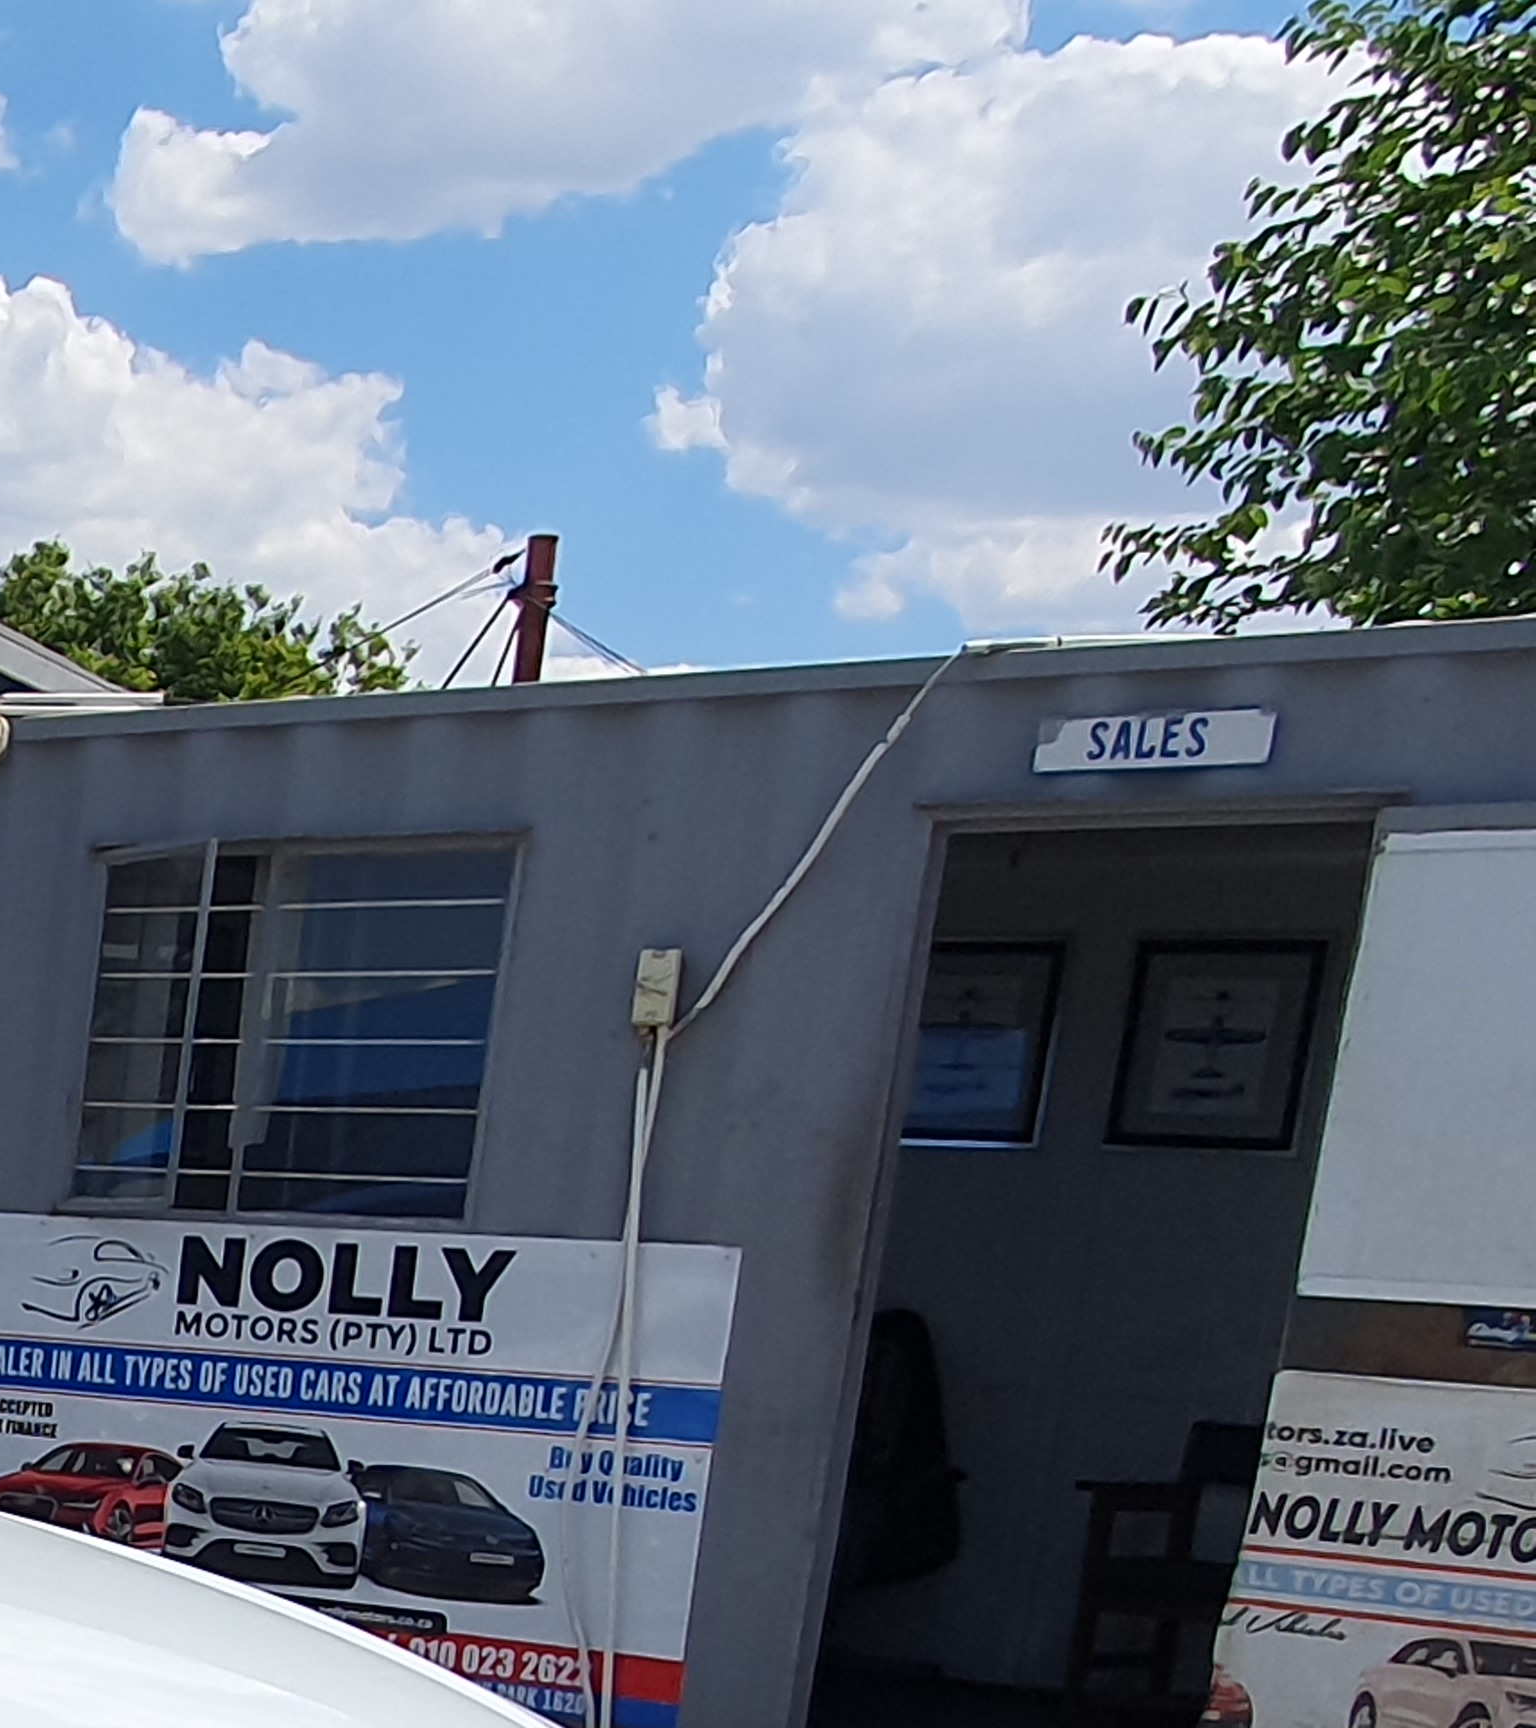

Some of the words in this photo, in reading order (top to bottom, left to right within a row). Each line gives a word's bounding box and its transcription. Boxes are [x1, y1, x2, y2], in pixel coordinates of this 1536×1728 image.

[1087, 717, 1209, 761] SALES
[176, 1235, 518, 1322] NOLLY
[174, 1310, 319, 1345] MOTORS
[329, 1318, 417, 1356] (PTY)
[428, 1326, 493, 1355] LTD
[50, 1349, 72, 1381] IN
[77, 1351, 117, 1385] ALL
[124, 1355, 193, 1391] TYPES
[198, 1360, 228, 1394] OF
[233, 1364, 294, 1399] USED
[299, 1368, 362, 1404] CARS
[368, 1373, 401, 1407] AT
[404, 1376, 567, 1421] AFFORDABLE
[1248, 1490, 1400, 1547] NOLLY
[1237, 1561, 1278, 1587] LL
[1291, 1569, 1386, 1601] TYPES
[1395, 1580, 1440, 1606] OF
[1448, 1587, 1536, 1618] USED
[461, 1643, 516, 1678] 023
